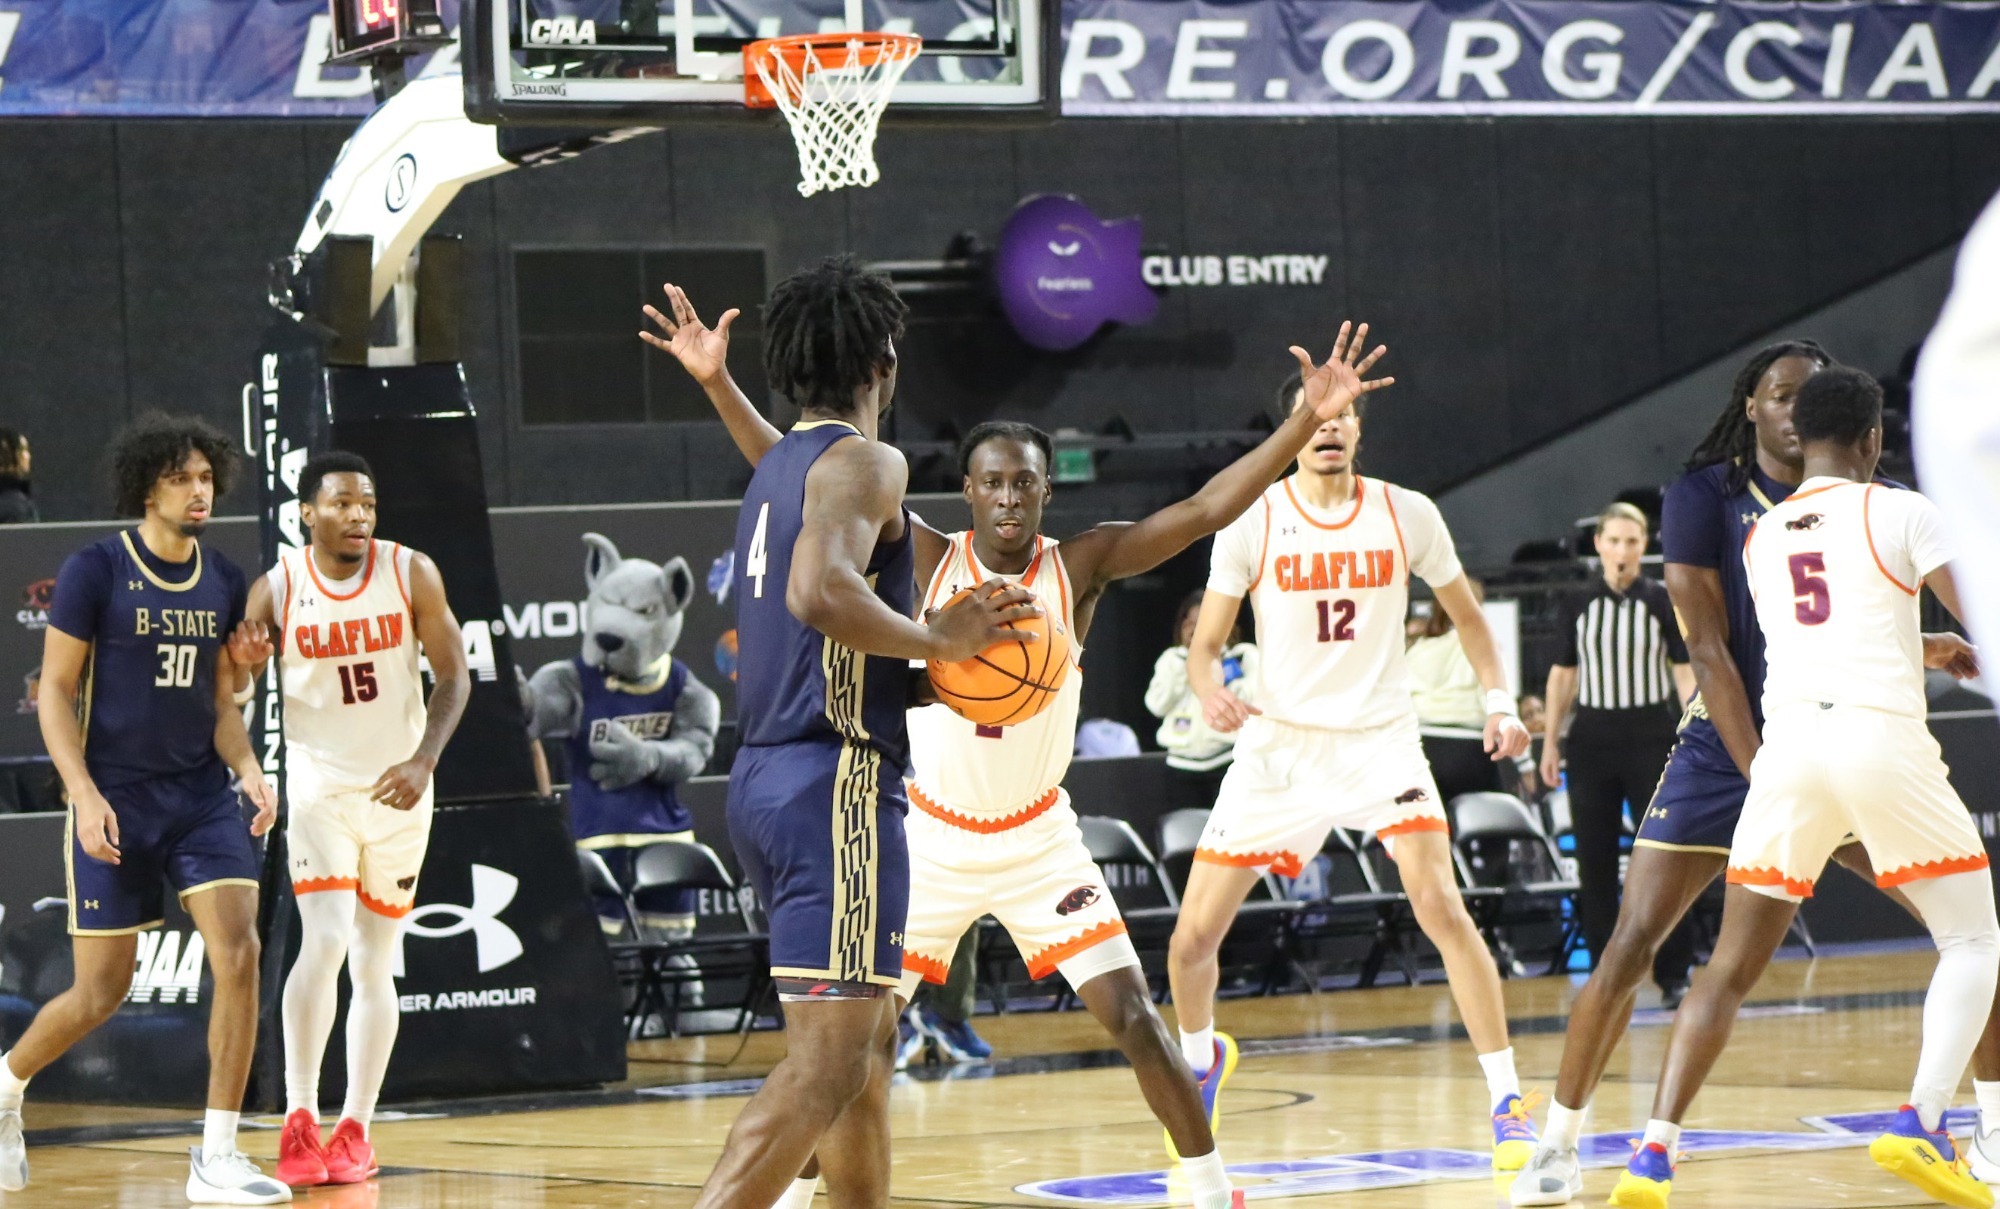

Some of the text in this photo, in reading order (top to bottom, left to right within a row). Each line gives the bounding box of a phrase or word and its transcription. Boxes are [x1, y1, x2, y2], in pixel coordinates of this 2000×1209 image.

[530, 19, 597, 45] CIAA
[511, 83, 568, 97] SPALDING
[1142, 254, 1329, 287] CLUB ENTRY
[746, 502, 769, 598] 4
[1273, 547, 1396, 592] CLAFLIN
[1787, 551, 1833, 627] 5
[135, 607, 218, 638] B-STATE
[295, 612, 404, 660] CLAFLIN
[1315, 598, 1356, 643] 12
[154, 643, 198, 688] 30
[337, 661, 379, 705] 15
[434, 987, 537, 1010] ARMOUR
